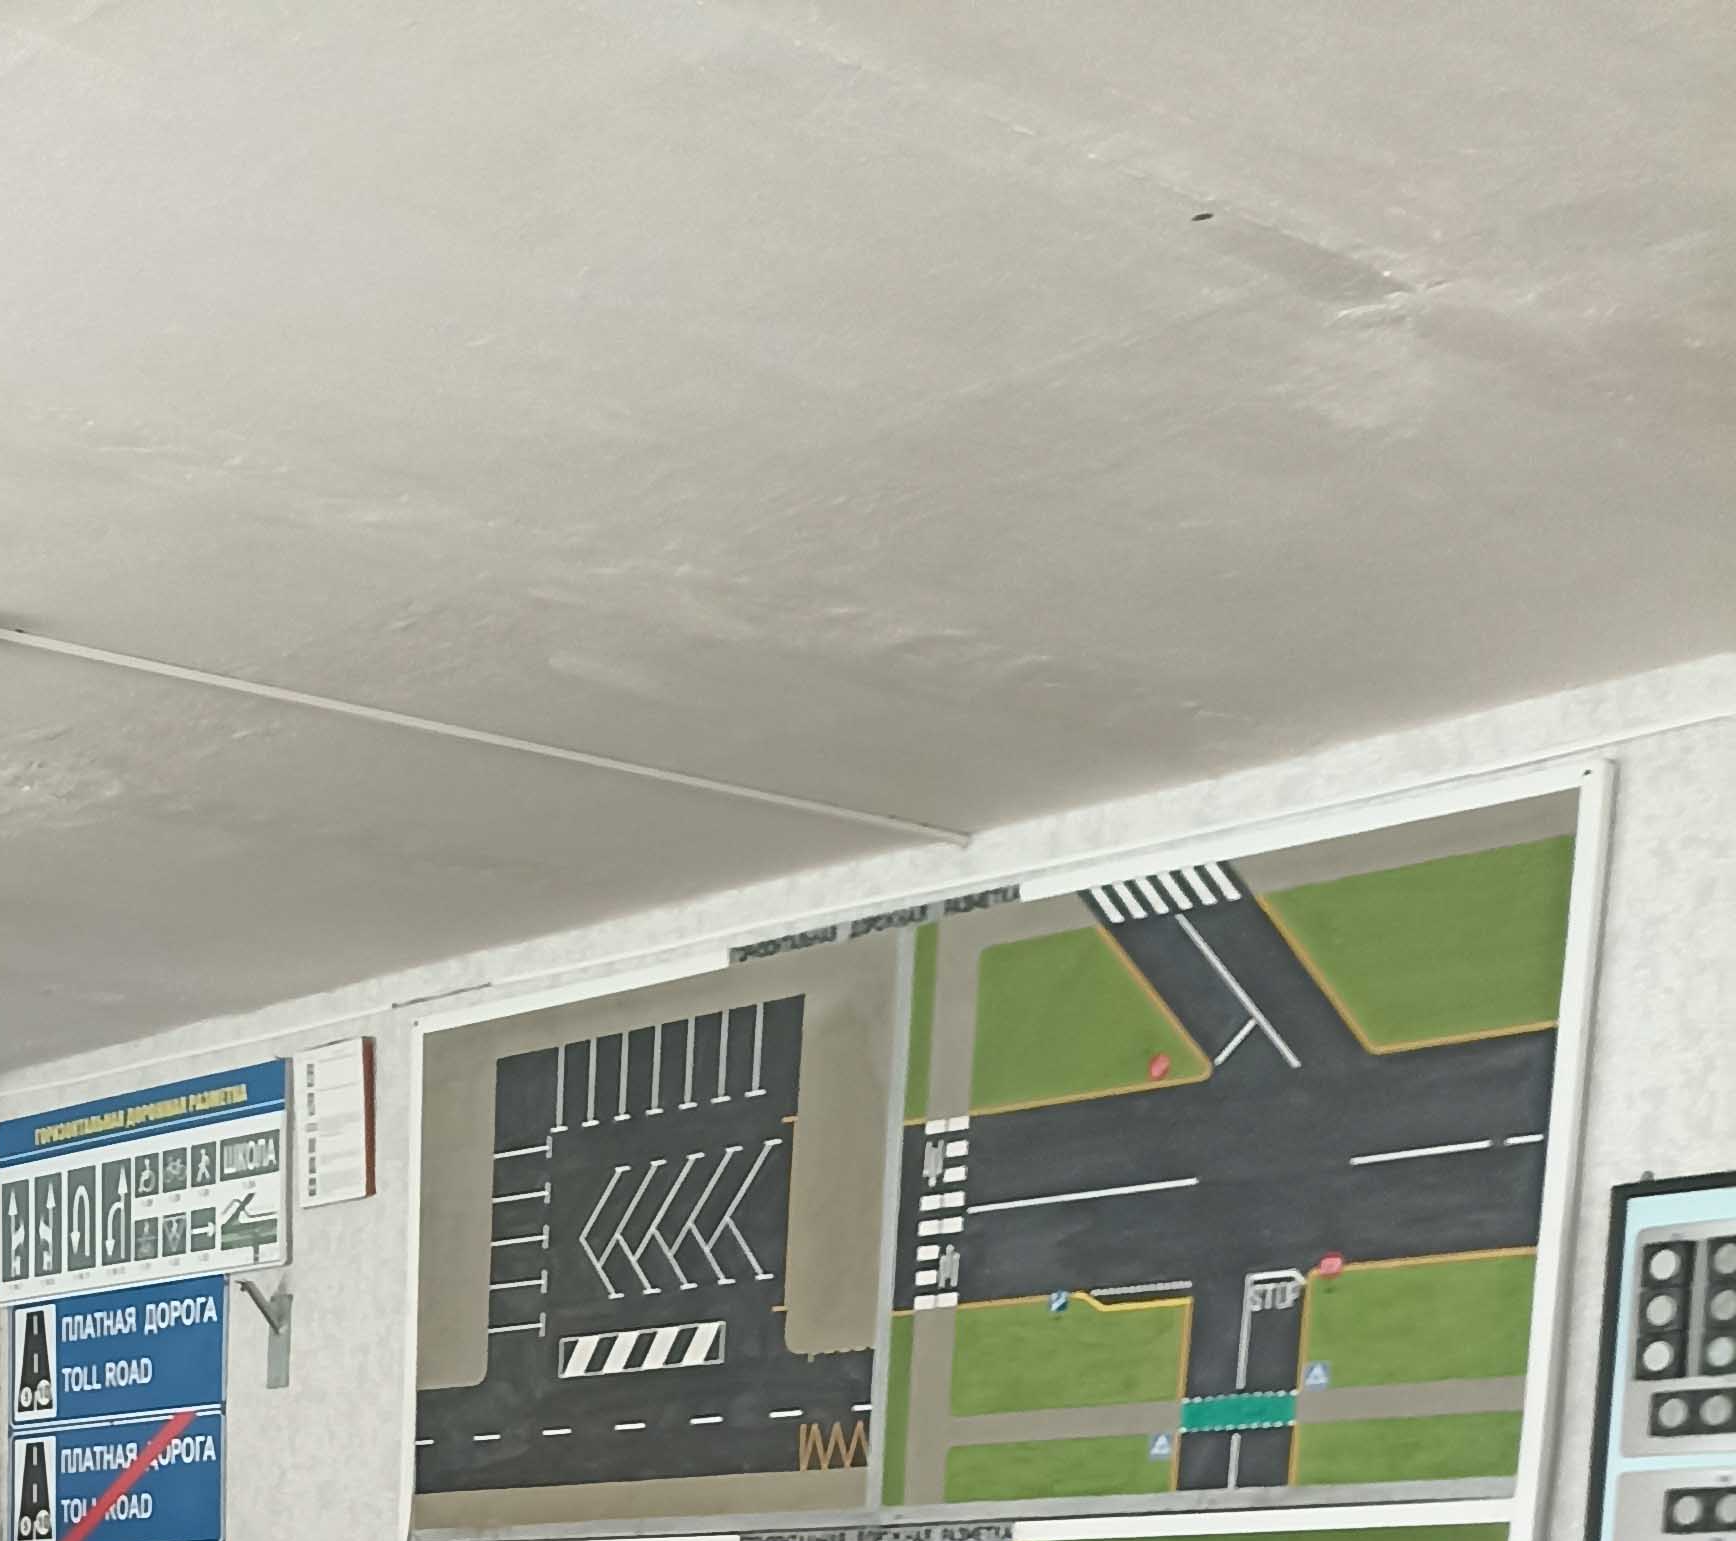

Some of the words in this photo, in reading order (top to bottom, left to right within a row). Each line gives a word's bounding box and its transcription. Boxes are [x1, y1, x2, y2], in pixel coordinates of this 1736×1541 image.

[223, 1135, 277, 1174] ШКОЛА
[62, 1307, 137, 1342] ПЛАТНАЯ
[144, 1296, 218, 1335] ДОРОГА
[61, 1364, 102, 1392] TOLL
[105, 1357, 153, 1388] ROAD
[61, 1442, 137, 1473] ПЛАТНАЯ
